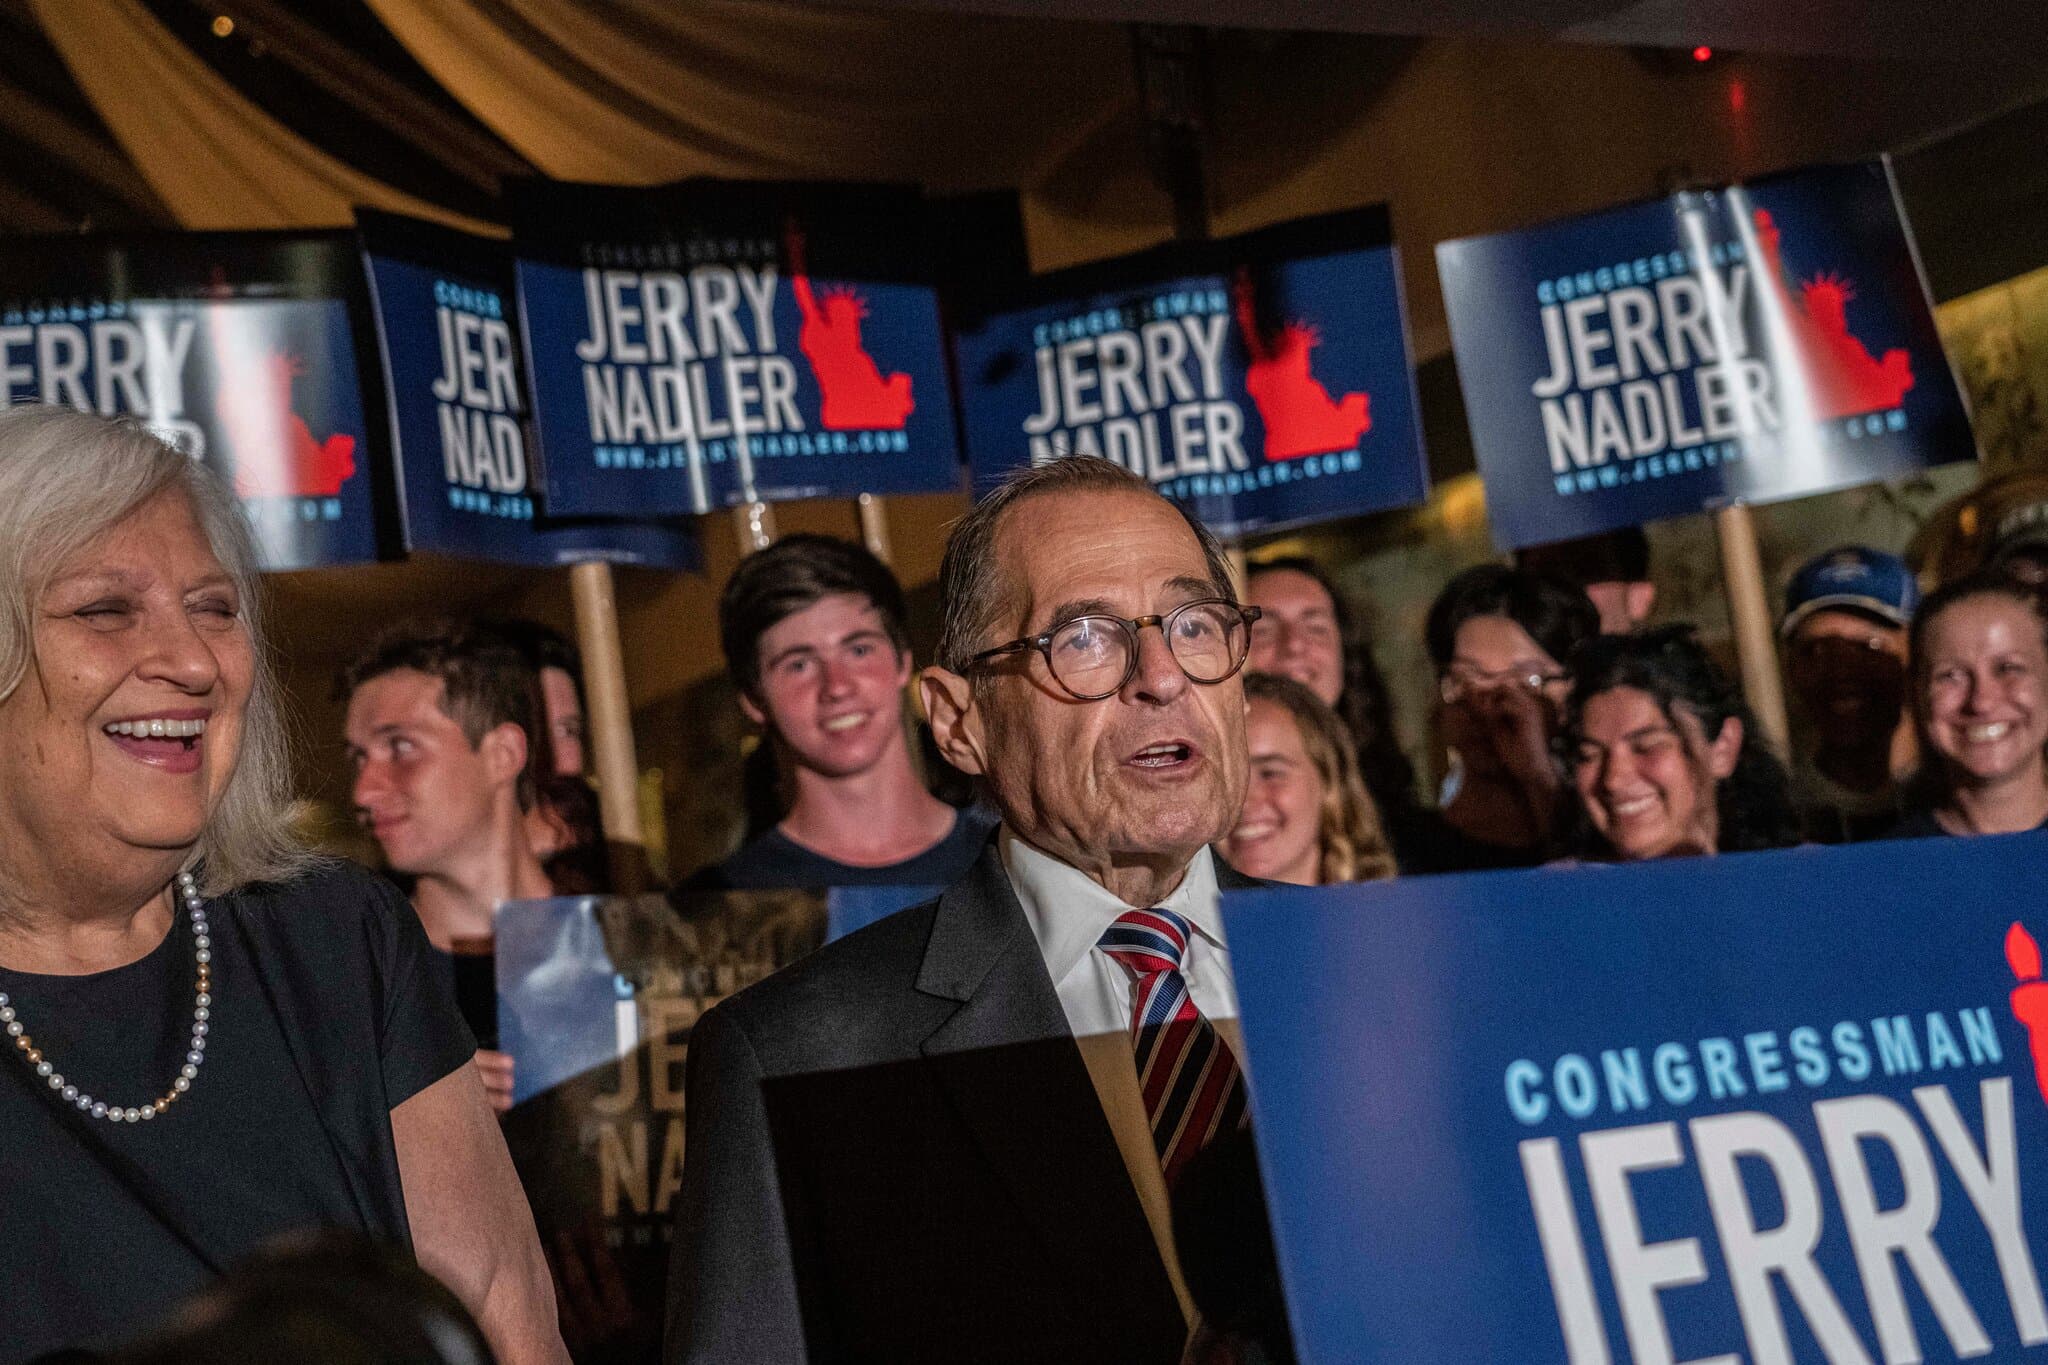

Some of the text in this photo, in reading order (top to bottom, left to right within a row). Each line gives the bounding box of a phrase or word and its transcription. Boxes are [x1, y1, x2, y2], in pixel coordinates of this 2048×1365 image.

[576, 265, 778, 363] JERRY
[1033, 289, 1228, 347] CONGRSMAN
[1537, 240, 1746, 304] CONGRESSAN
[1023, 314, 1230, 434] JERRY
[1532, 266, 1750, 398] JERRY
[438, 403, 527, 494] NAD
[583, 355, 804, 444] NADLER
[1540, 359, 1782, 473] NADLER
[1504, 1006, 2003, 1125] CONGRESSMAN
[1518, 1076, 2048, 1365] JERRY
